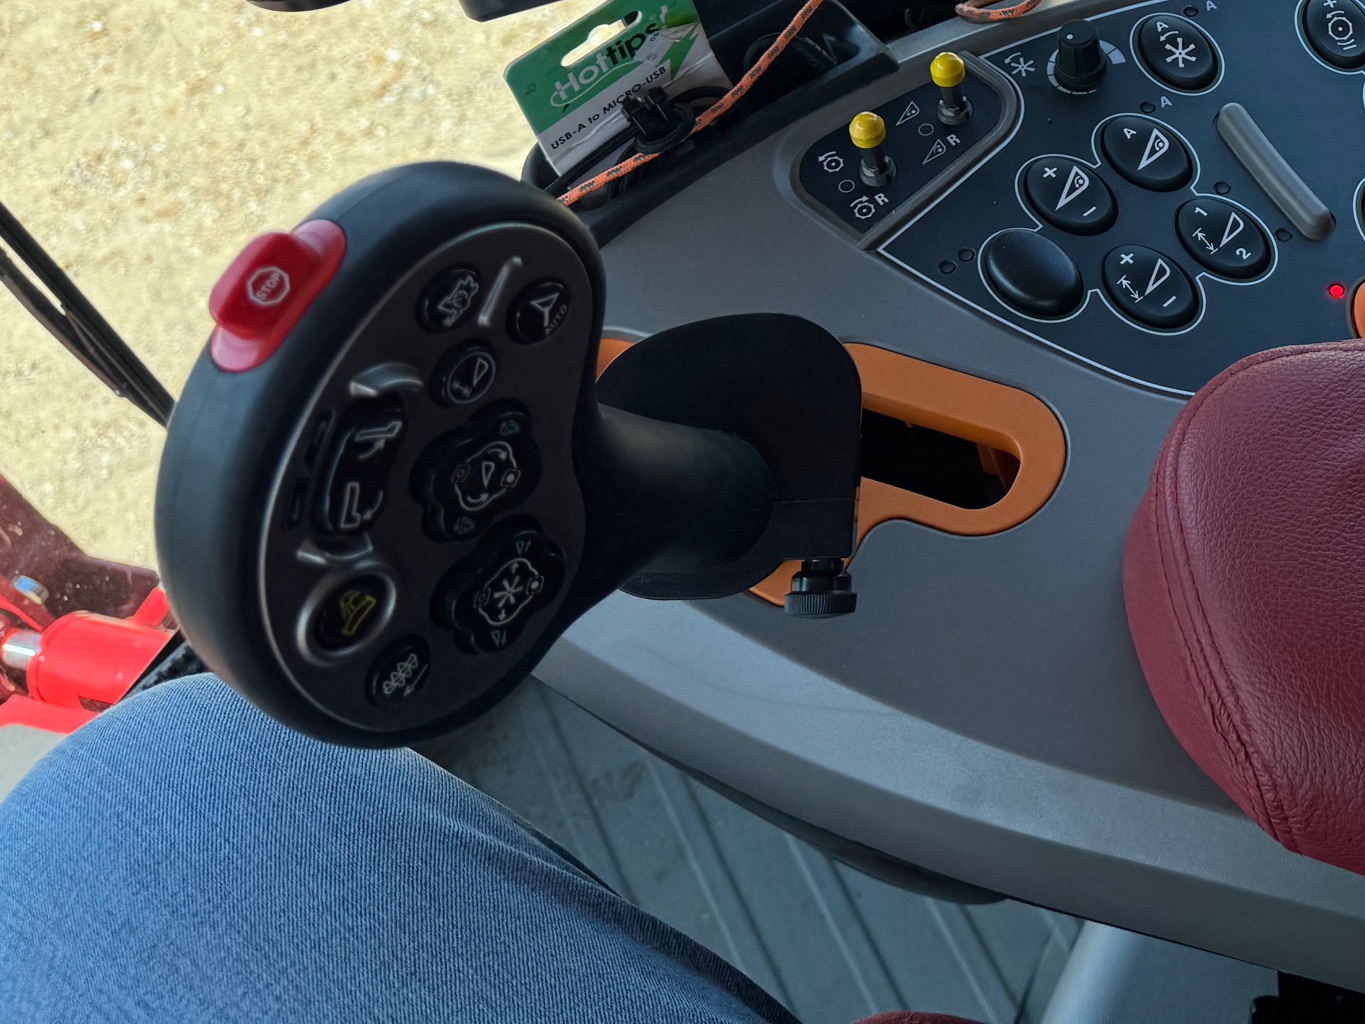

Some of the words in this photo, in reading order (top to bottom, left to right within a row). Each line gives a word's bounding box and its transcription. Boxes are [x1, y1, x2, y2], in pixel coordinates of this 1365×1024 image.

[1206, 0, 1217, 12] A
[1156, 21, 1169, 32] A
[1160, 95, 1173, 108] A
[551, 123, 587, 151] USB-A
[588, 113, 600, 125] to
[602, 66, 667, 115] MICRO-USB
[1122, 126, 1137, 139] A
[946, 133, 961, 147] R
[874, 193, 889, 206] R
[1194, 206, 1208, 217] 1
[1235, 247, 1252, 261] 2
[256, 272, 280, 302] STOP
[545, 304, 568, 336] AUTO
